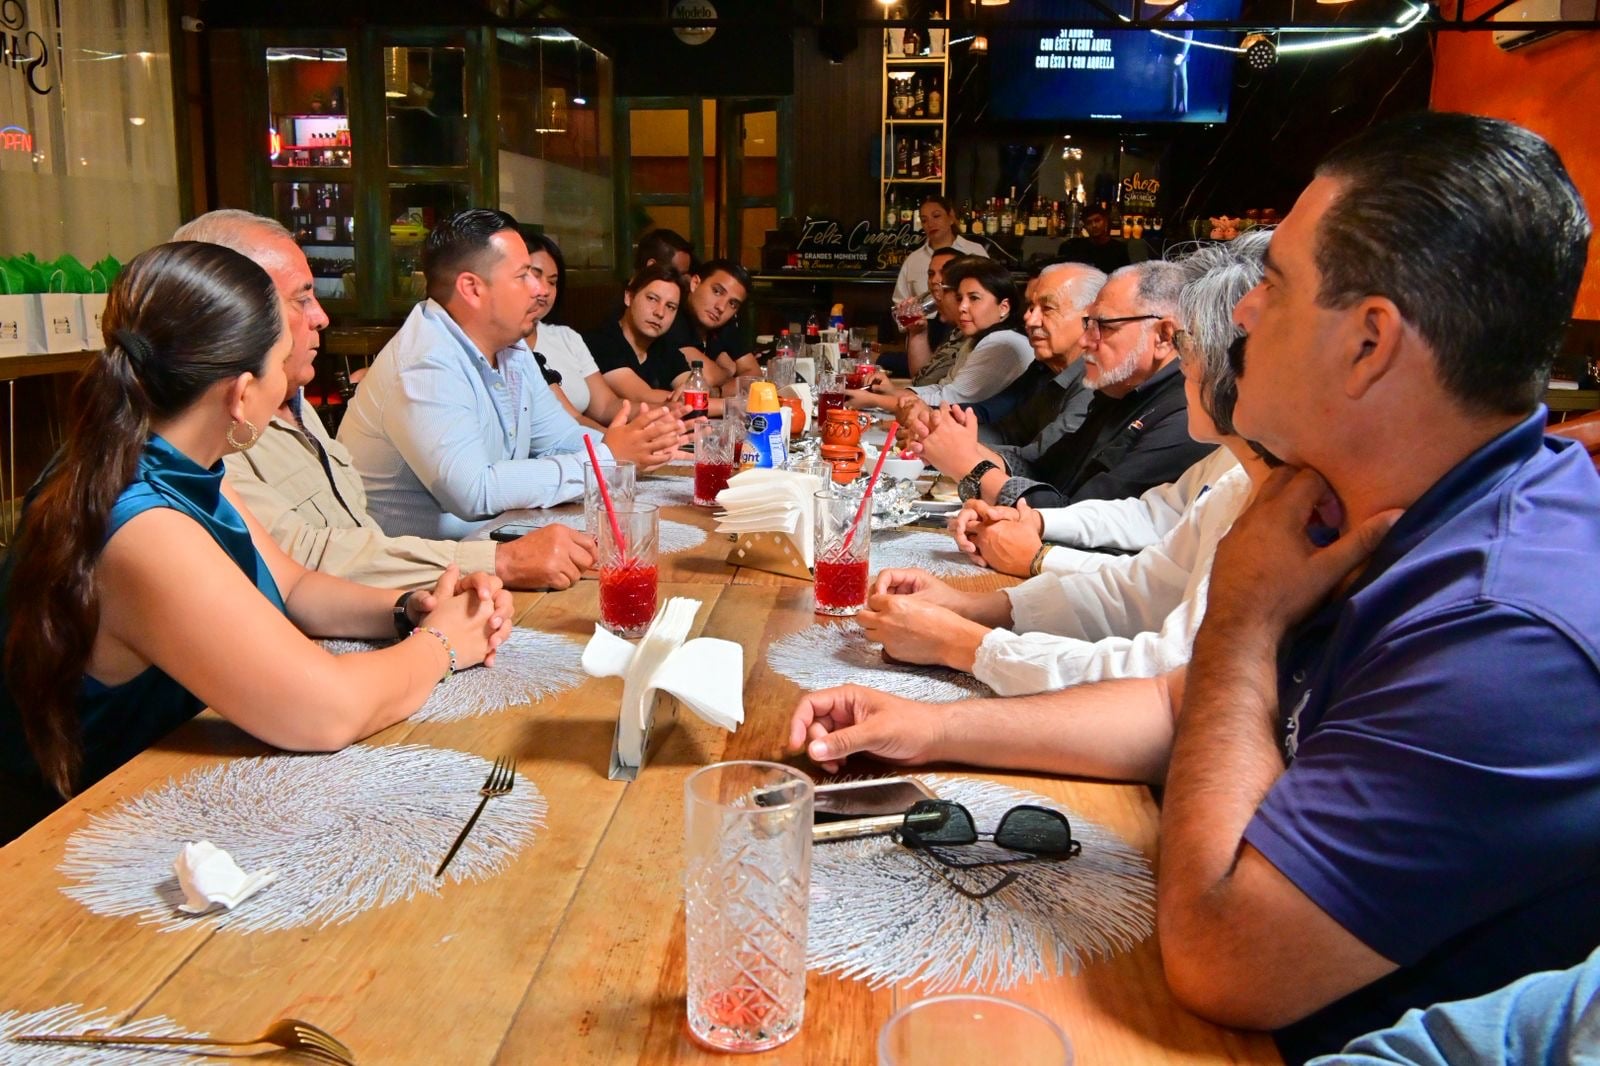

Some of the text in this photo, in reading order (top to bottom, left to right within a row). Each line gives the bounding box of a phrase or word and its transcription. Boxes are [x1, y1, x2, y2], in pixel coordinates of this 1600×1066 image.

[676, 6, 711, 18] Modelo
[1040, 36, 1112, 52] CON ÉSTE Y CON AQUEL
[1035, 53, 1115, 69] CON ÉSTA Y CON AQUELLA
[797, 221, 843, 250] Feliz
[741, 452, 760, 463] ght
